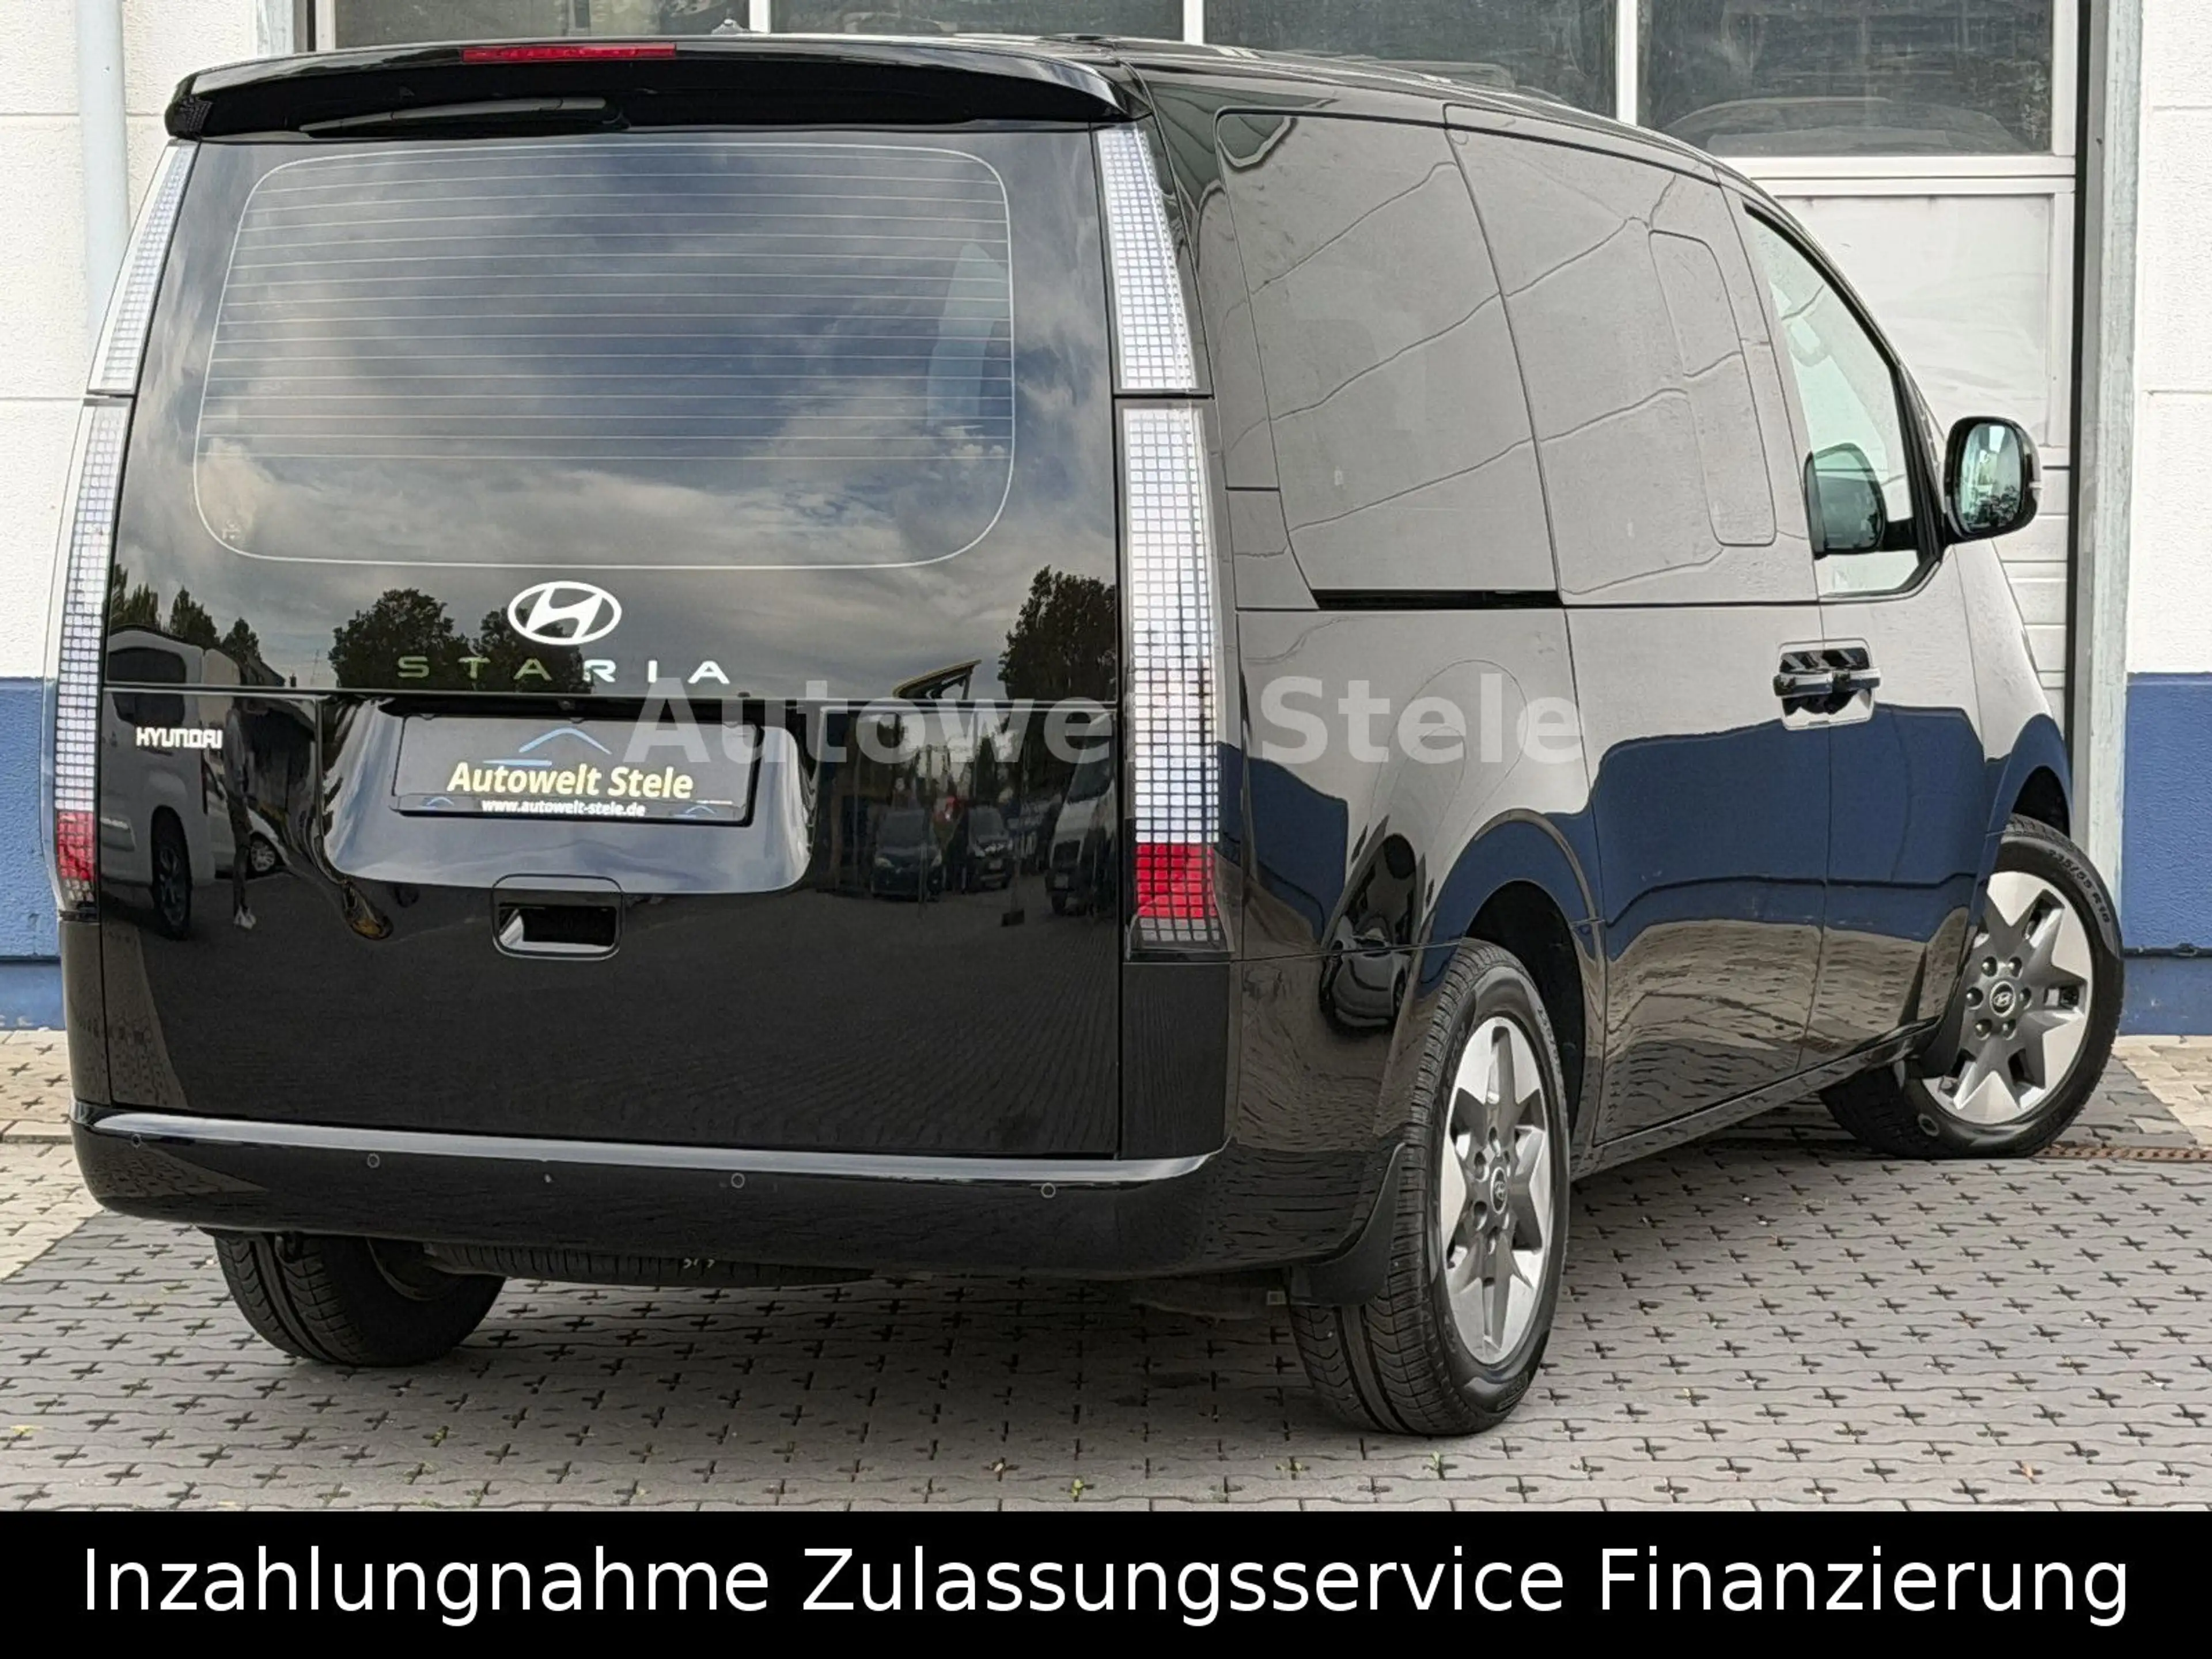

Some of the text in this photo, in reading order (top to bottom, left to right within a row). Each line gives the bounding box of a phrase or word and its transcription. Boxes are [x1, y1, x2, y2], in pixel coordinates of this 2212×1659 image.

[397, 656, 730, 684] STARIA
[136, 727, 223, 749] HYUNDAI
[446, 762, 694, 798] Autowelt Stele
[480, 798, 646, 816] www.autowelt-stele.de
